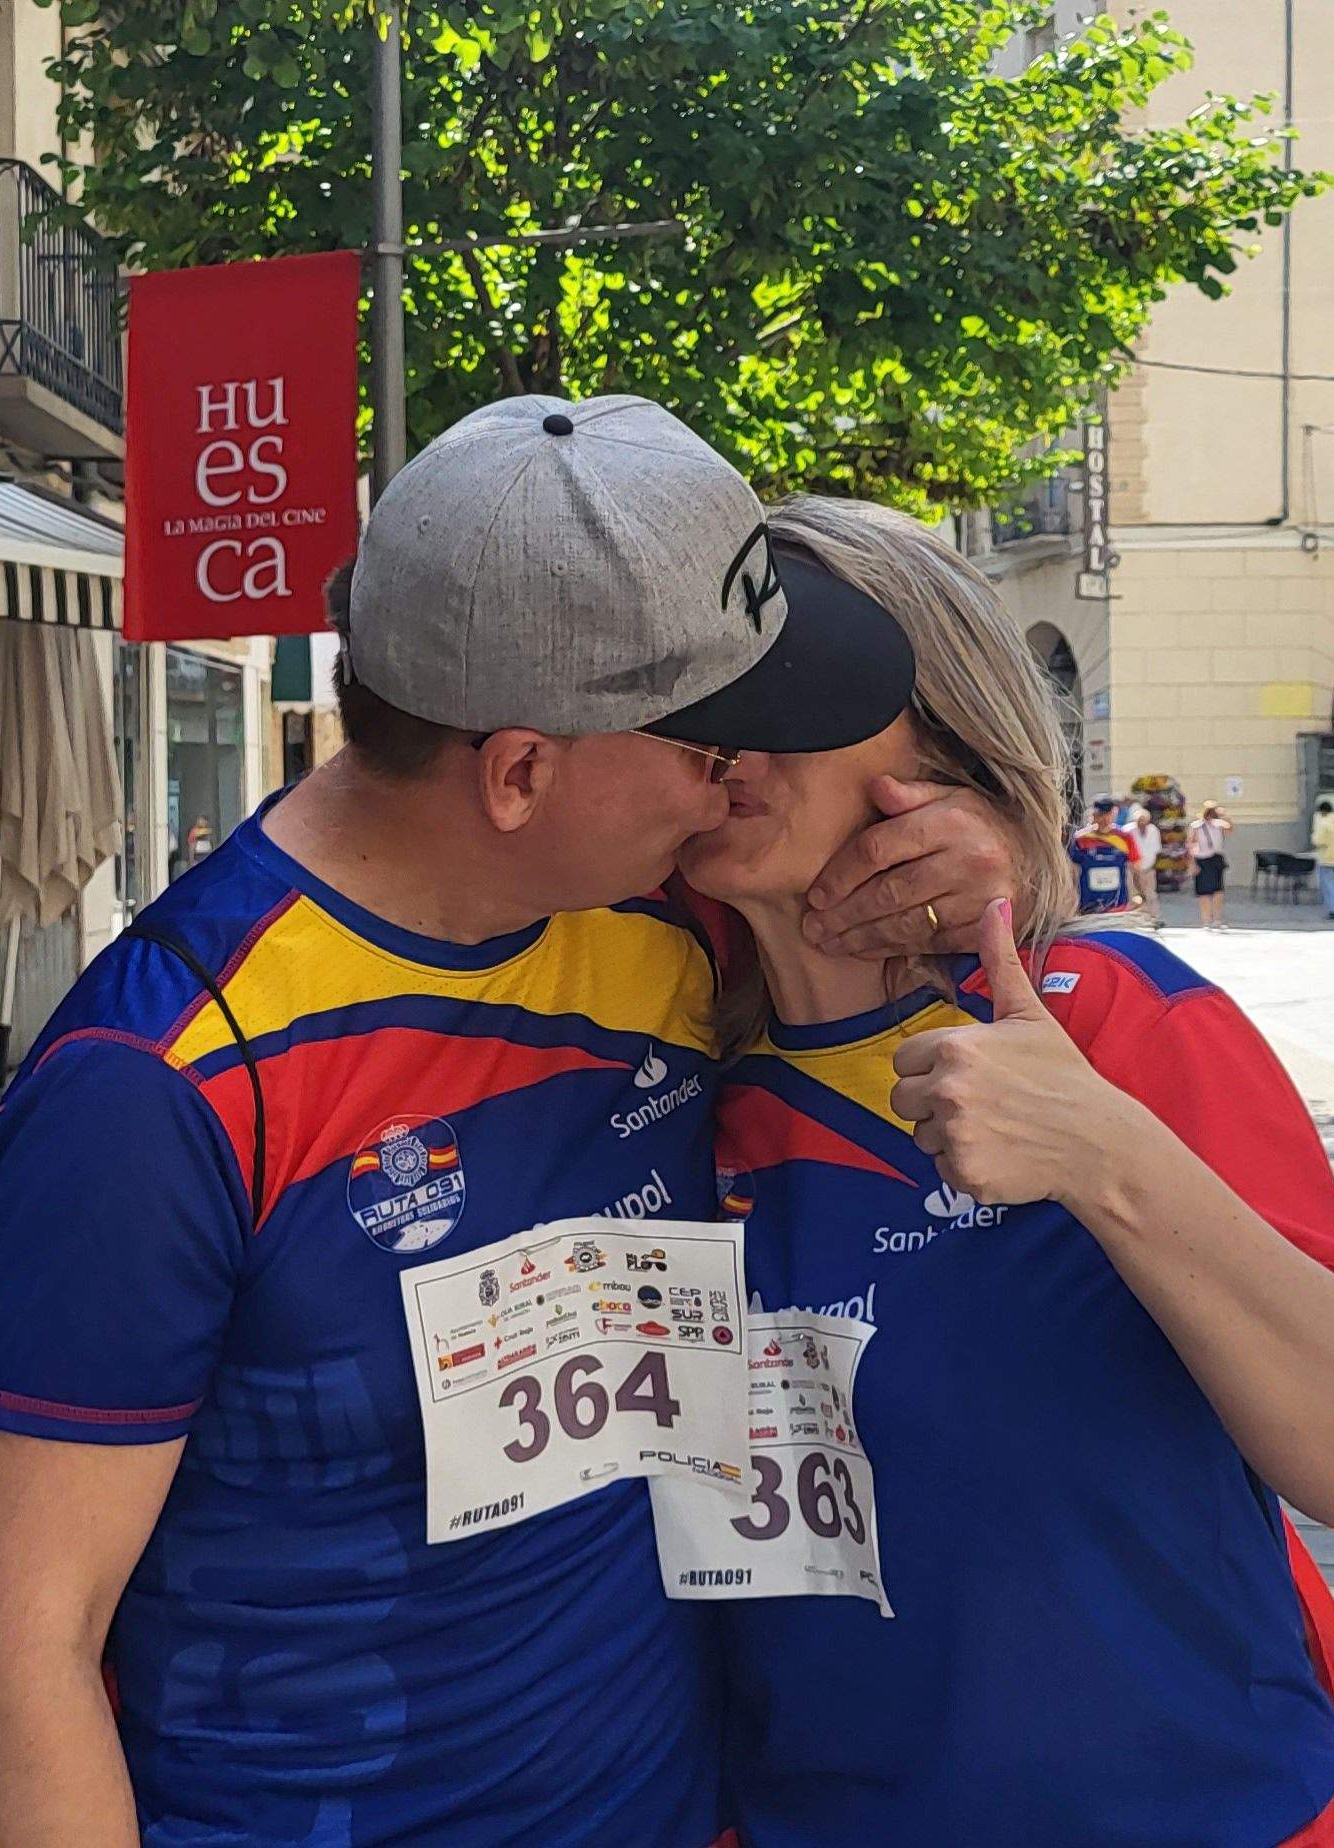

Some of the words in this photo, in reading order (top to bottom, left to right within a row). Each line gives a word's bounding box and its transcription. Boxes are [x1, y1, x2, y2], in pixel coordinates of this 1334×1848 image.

[1088, 426, 1105, 571] HOSTAL
[610, 1074, 703, 1139] Santander
[360, 1192, 419, 1226] RUTA
[426, 1173, 463, 1200] 091
[588, 1169, 672, 1219] upol
[873, 1206, 1008, 1253] Santder
[509, 1271, 551, 1293] Santander
[499, 1350, 681, 1463] 364
[449, 1492, 525, 1530] #RUTA091
[730, 1452, 866, 1545] 363
[679, 1568, 753, 1587] #RUTA091
